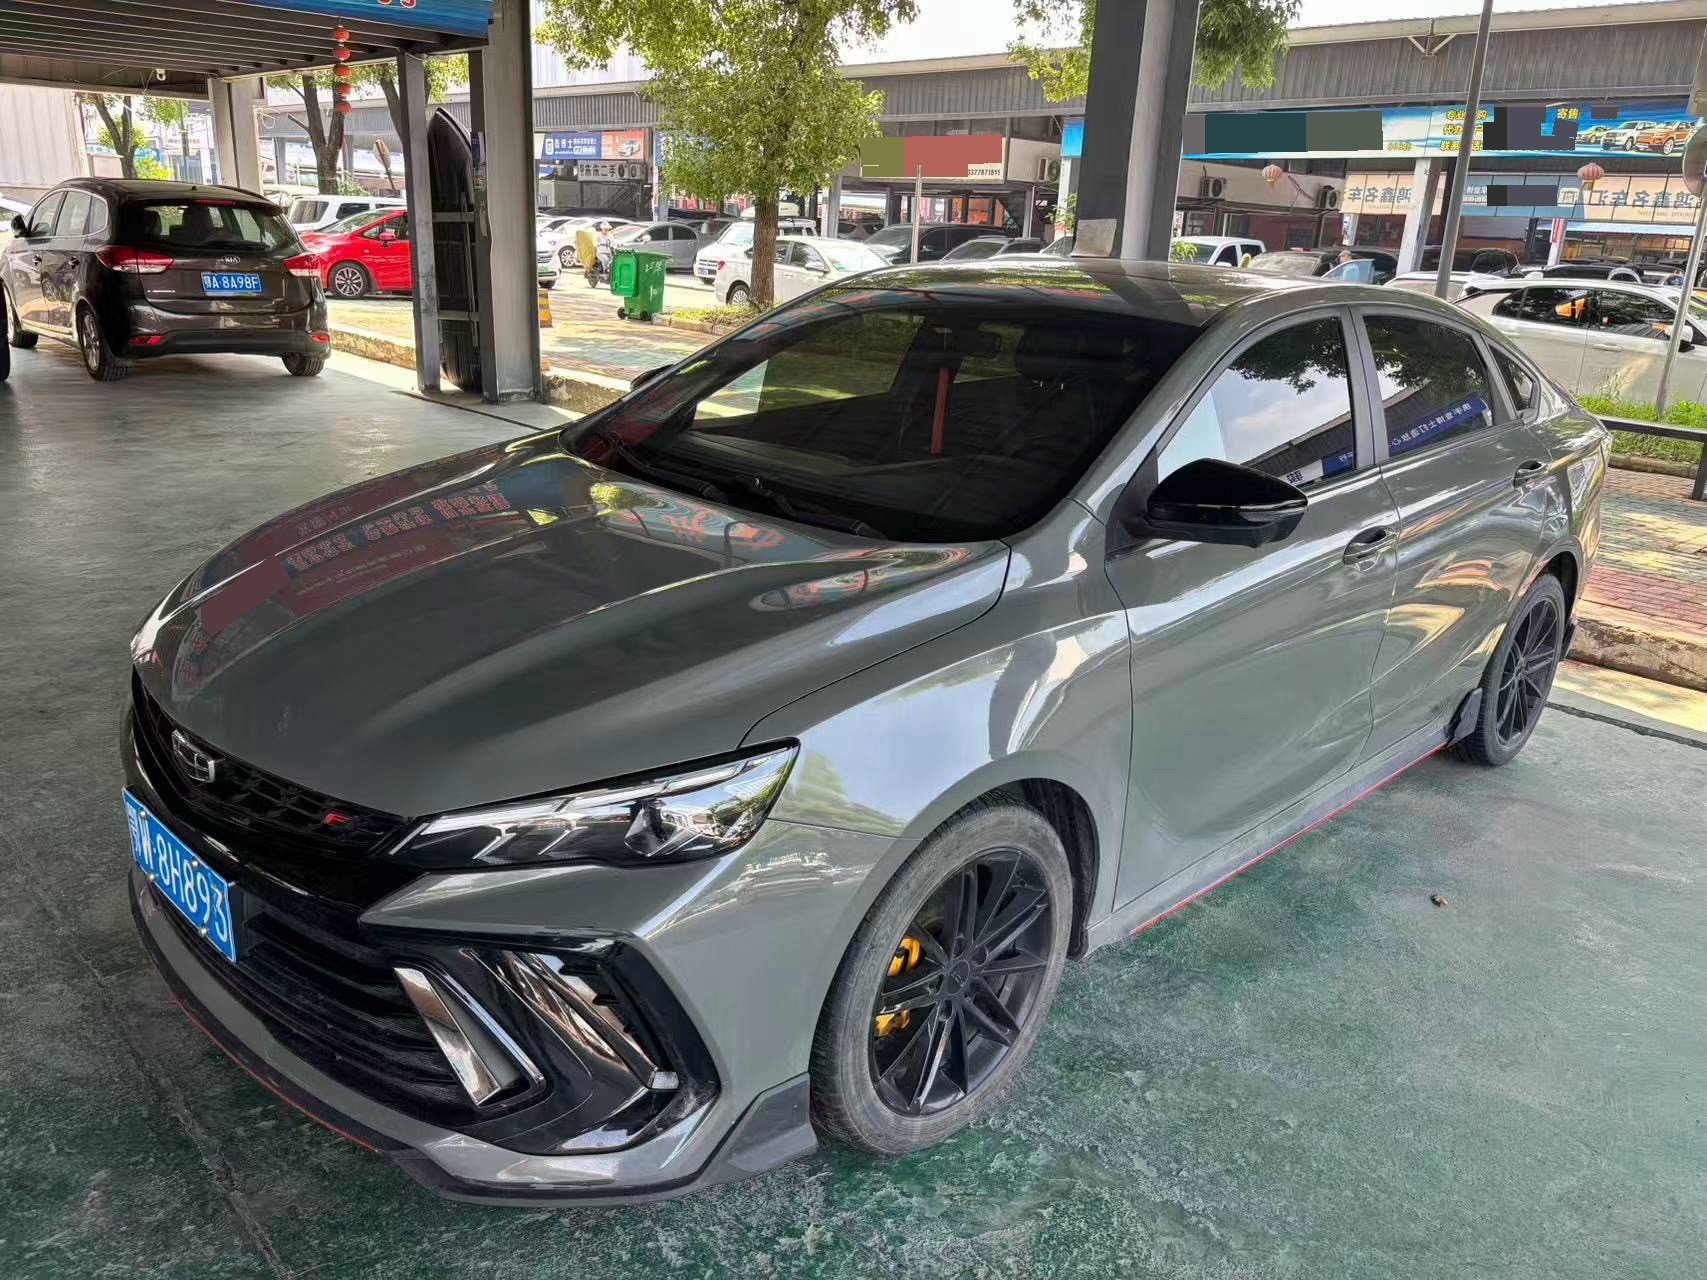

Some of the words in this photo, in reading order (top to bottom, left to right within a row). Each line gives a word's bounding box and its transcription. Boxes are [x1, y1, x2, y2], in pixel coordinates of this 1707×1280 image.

[1446, 109, 1488, 121] 专业购
[1443, 124, 1484, 136] 代办户
[1440, 140, 1482, 152] 联系话
